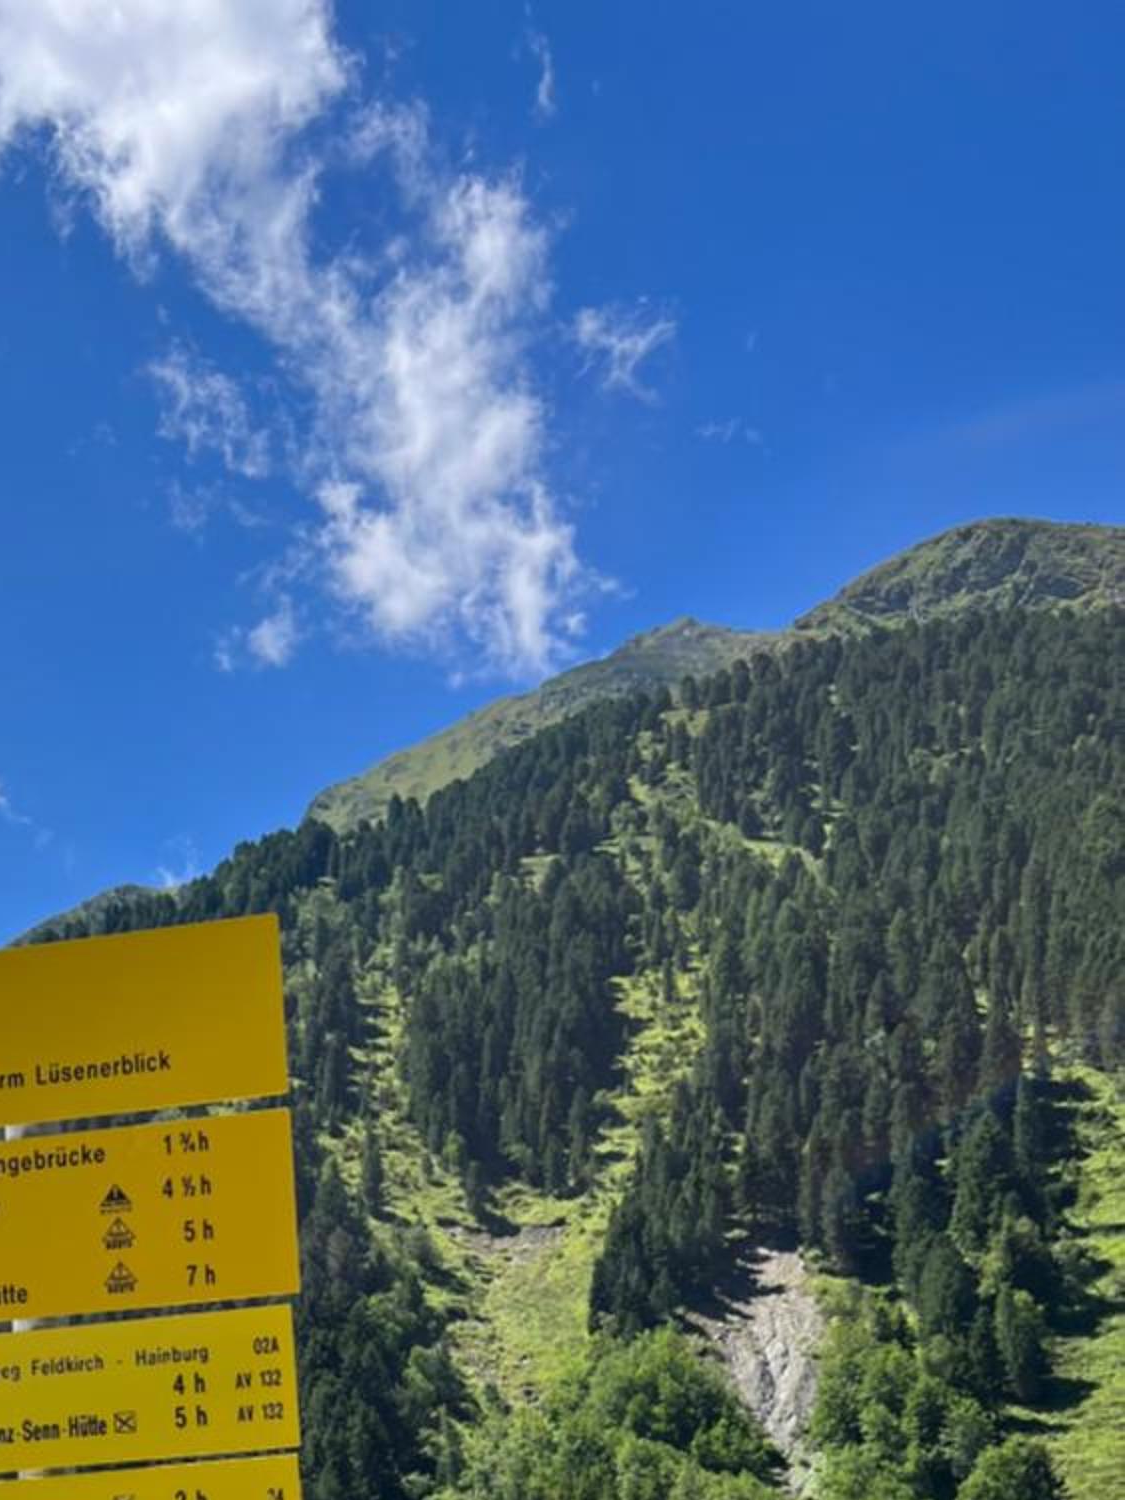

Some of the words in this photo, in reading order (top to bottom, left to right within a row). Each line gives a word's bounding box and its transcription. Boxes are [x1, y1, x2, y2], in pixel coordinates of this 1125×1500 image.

[35, 1051, 171, 1086] Lüsenerblick
[163, 1135, 172, 1155] 1
[197, 1130, 210, 1152] h
[162, 1178, 174, 1199] 4
[199, 1175, 212, 1196] h
[183, 1219, 196, 1243] 5
[202, 1219, 214, 1240] h
[186, 1264, 198, 1286] 7
[204, 1264, 216, 1285] h
[30, 1355, 104, 1376] Feldkirch
[135, 1347, 209, 1367] Hainburg
[172, 1373, 186, 1395] 4
[193, 1372, 206, 1394] h
[235, 1373, 252, 1389] AV
[259, 1368, 282, 1387] 132
[174, 1405, 188, 1429] 5
[195, 1404, 208, 1427] h
[237, 1405, 254, 1422] AV
[261, 1401, 284, 1420] 132
